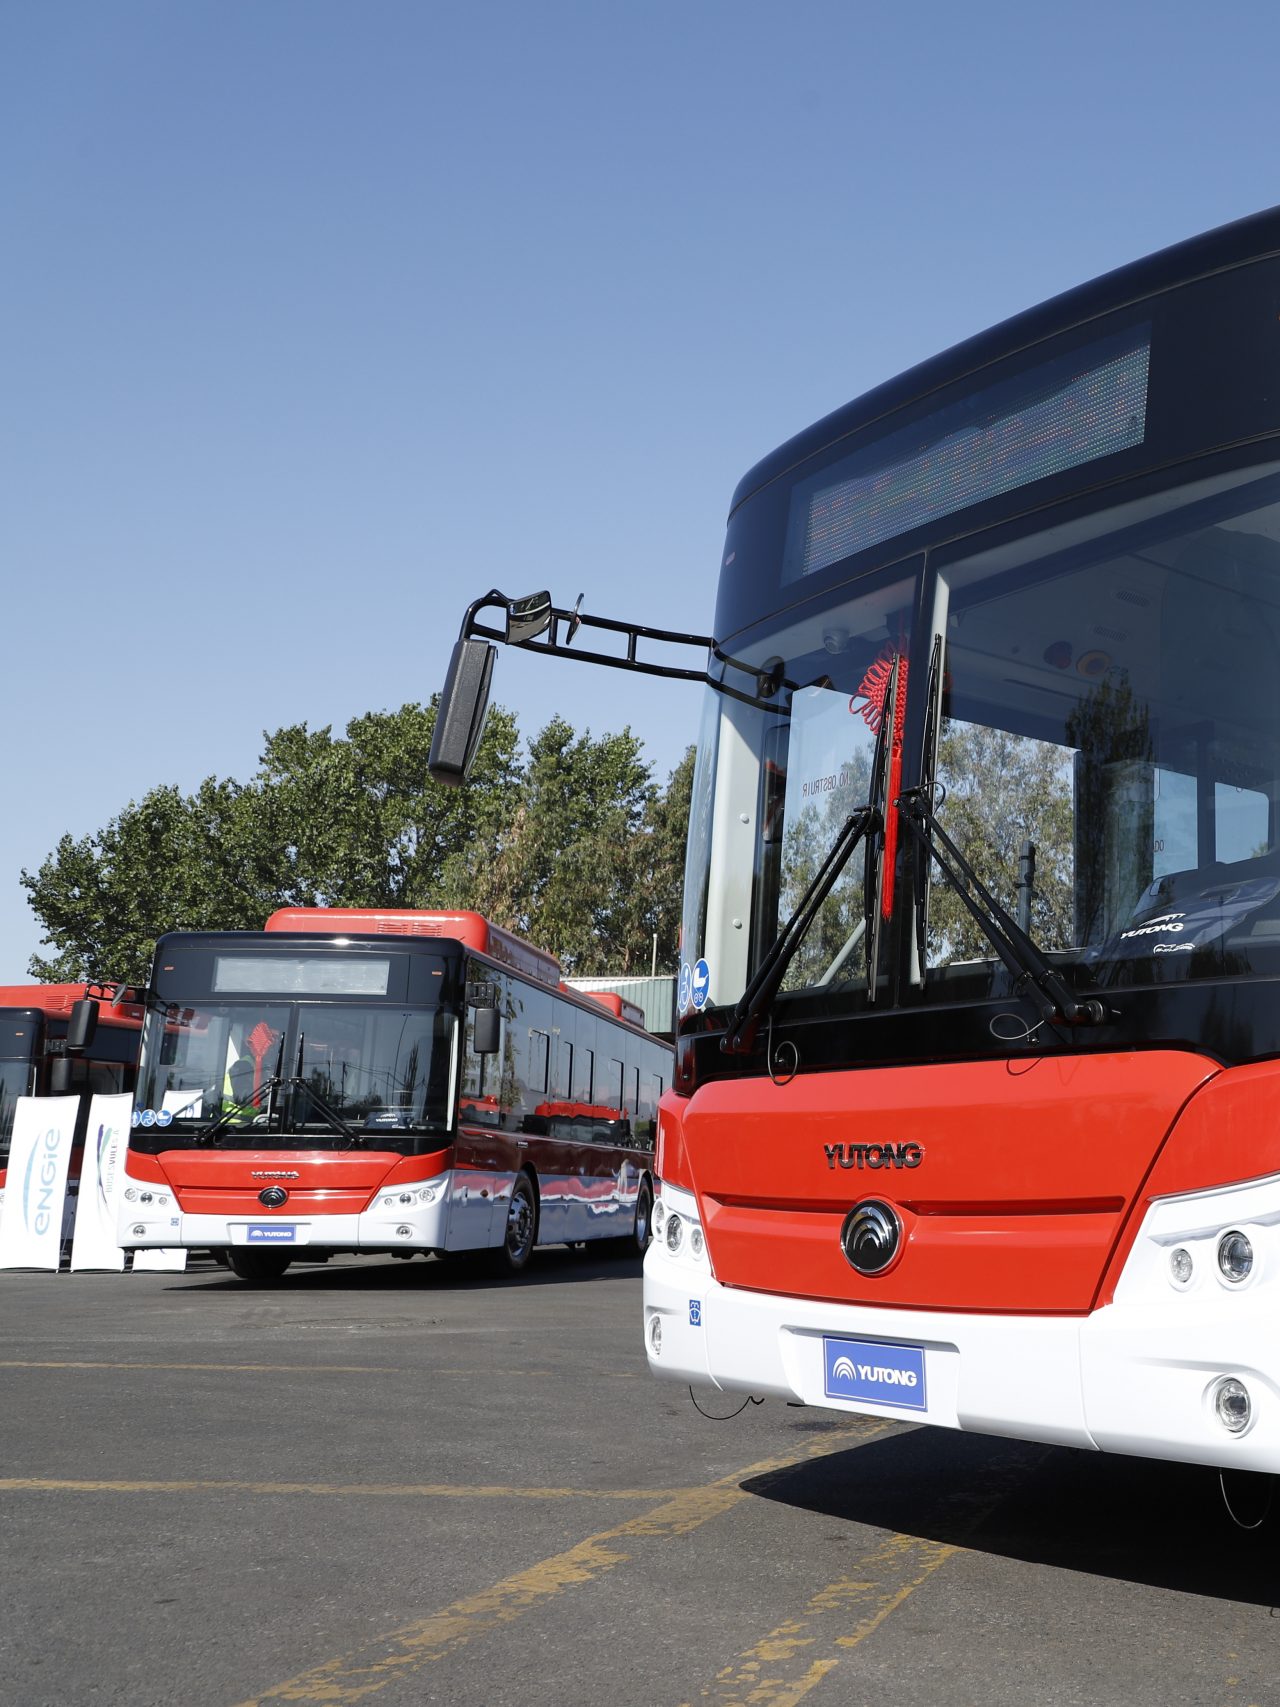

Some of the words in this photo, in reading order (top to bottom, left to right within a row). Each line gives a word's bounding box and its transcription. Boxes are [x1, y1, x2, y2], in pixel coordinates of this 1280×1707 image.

[1120, 922, 1184, 940] YUTONG
[824, 1142, 922, 1169] YUTONG
[857, 1364, 918, 1387] YUTONG
